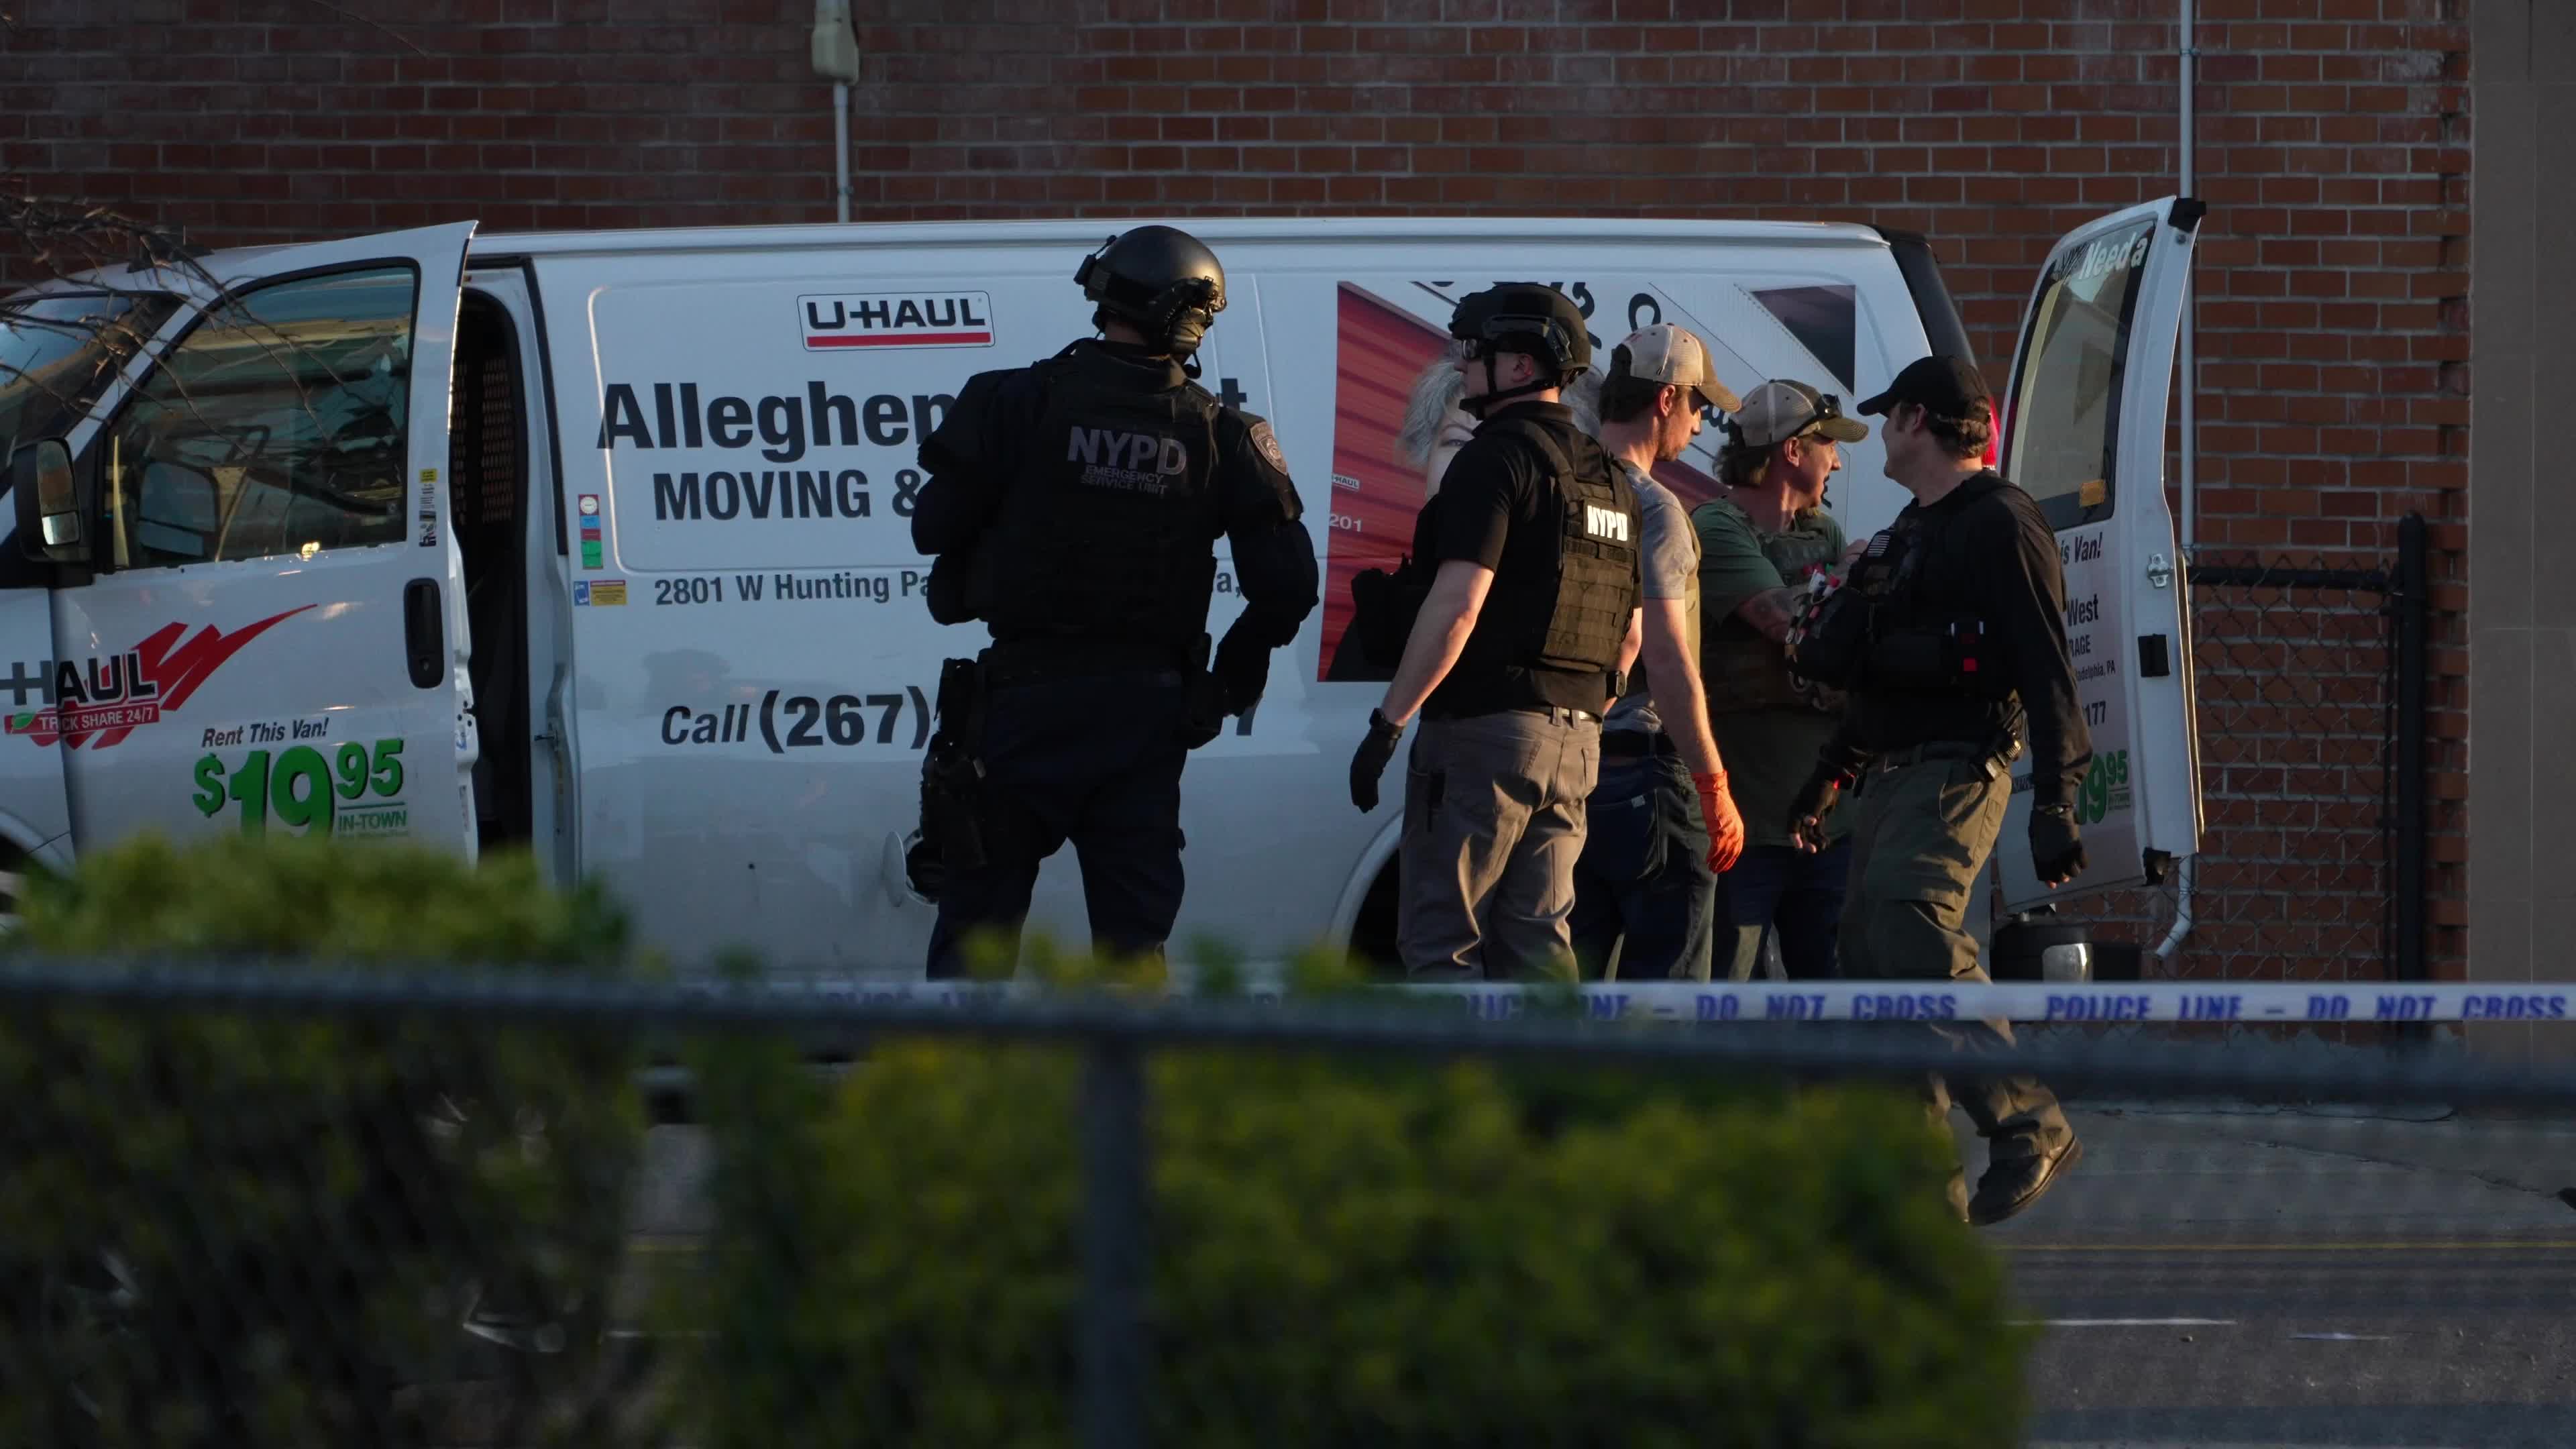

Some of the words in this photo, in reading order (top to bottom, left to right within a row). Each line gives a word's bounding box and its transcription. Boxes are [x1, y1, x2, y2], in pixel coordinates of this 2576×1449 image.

[2079, 232, 2137, 279] Need
[2131, 237, 2148, 268] a
[596, 381, 956, 463] Alleghen
[1068, 425, 1186, 475] NYPD
[1085, 466, 1165, 484] EMERGENCY
[653, 470, 871, 520] MOVING
[892, 470, 922, 517] &
[1587, 504, 1627, 541] NYPD
[2075, 532, 2102, 563] Van!
[655, 577, 723, 604] 2801
[736, 575, 764, 601] W
[775, 573, 890, 603] Hunting
[2067, 593, 2098, 627] West
[2106, 660, 2116, 674] PA
[38, 716, 78, 731] TRCK
[82, 713, 123, 729] SHARE
[126, 707, 154, 723] 24/7
[202, 727, 244, 747] Rent
[250, 722, 285, 743] This
[292, 717, 329, 739] Van!
[661, 703, 750, 745] Call
[759, 686, 931, 753] (267)
[1696, 995, 1739, 1020] DO
[1766, 995, 1825, 1020] NOT
[1851, 995, 1957, 1020] CROSS
[2044, 996, 2152, 1020] POLICE
[2178, 996, 2243, 1020] LINE
[2306, 996, 2351, 1019] DO
[2375, 996, 2437, 1019] NOT
[2461, 996, 2567, 1019] CROSS
